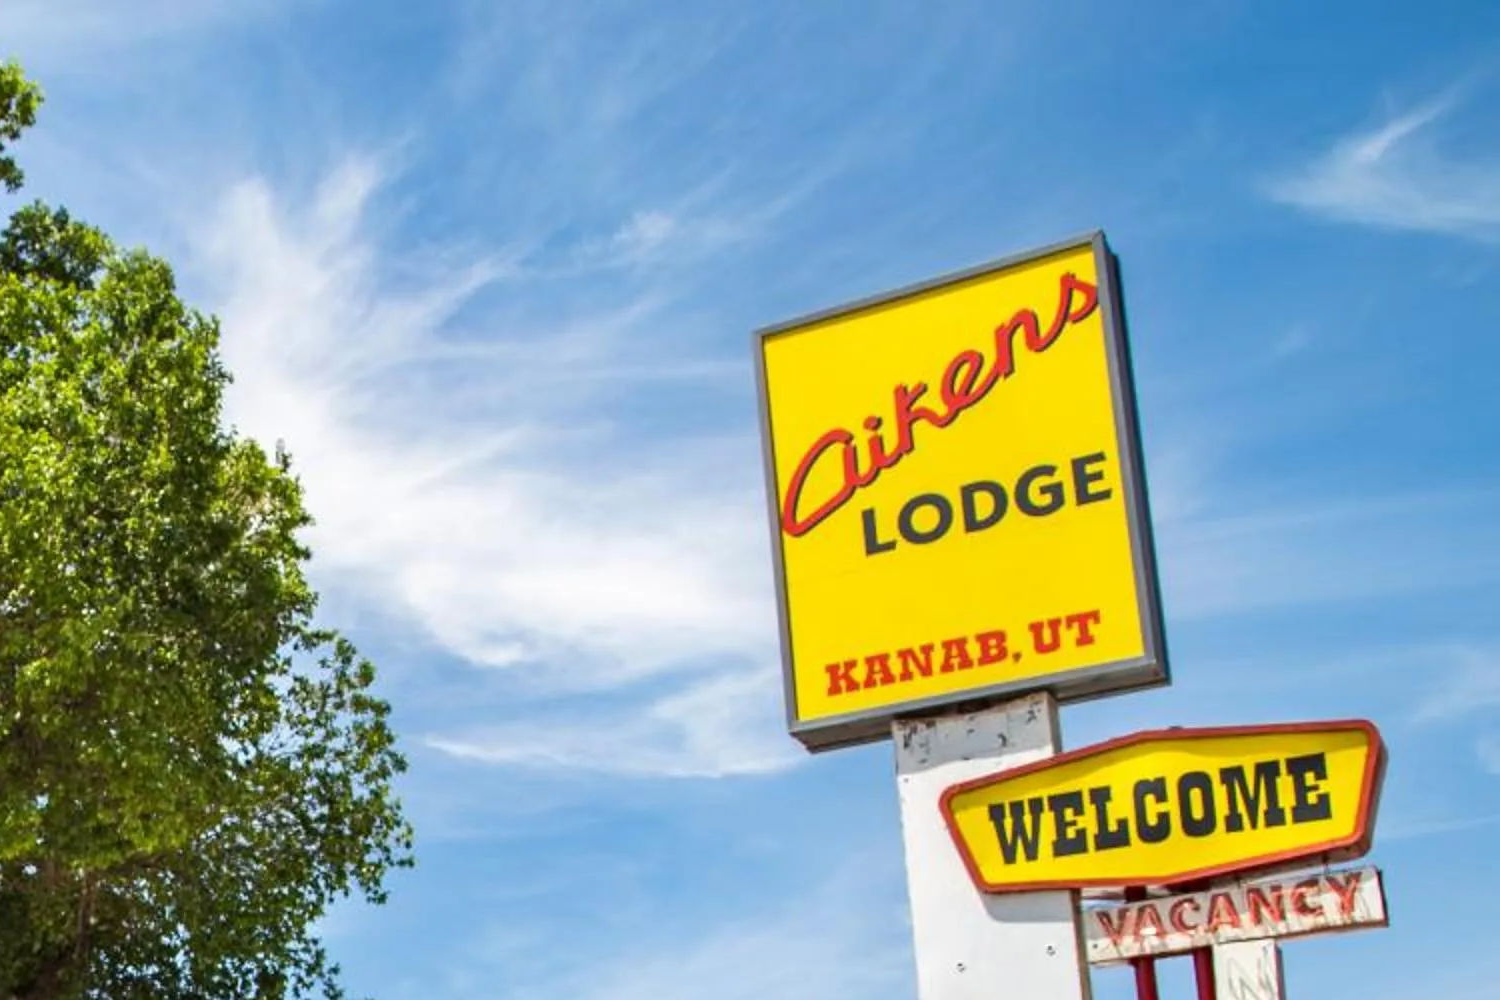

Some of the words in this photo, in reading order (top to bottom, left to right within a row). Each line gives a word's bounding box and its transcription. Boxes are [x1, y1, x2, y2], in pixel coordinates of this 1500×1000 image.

[781, 271, 1100, 538] Aikens
[860, 451, 1113, 556] LODGE
[1028, 609, 1101, 656] UT
[988, 752, 1332, 865] WELCOME
[1095, 870, 1363, 945] VACANCY
